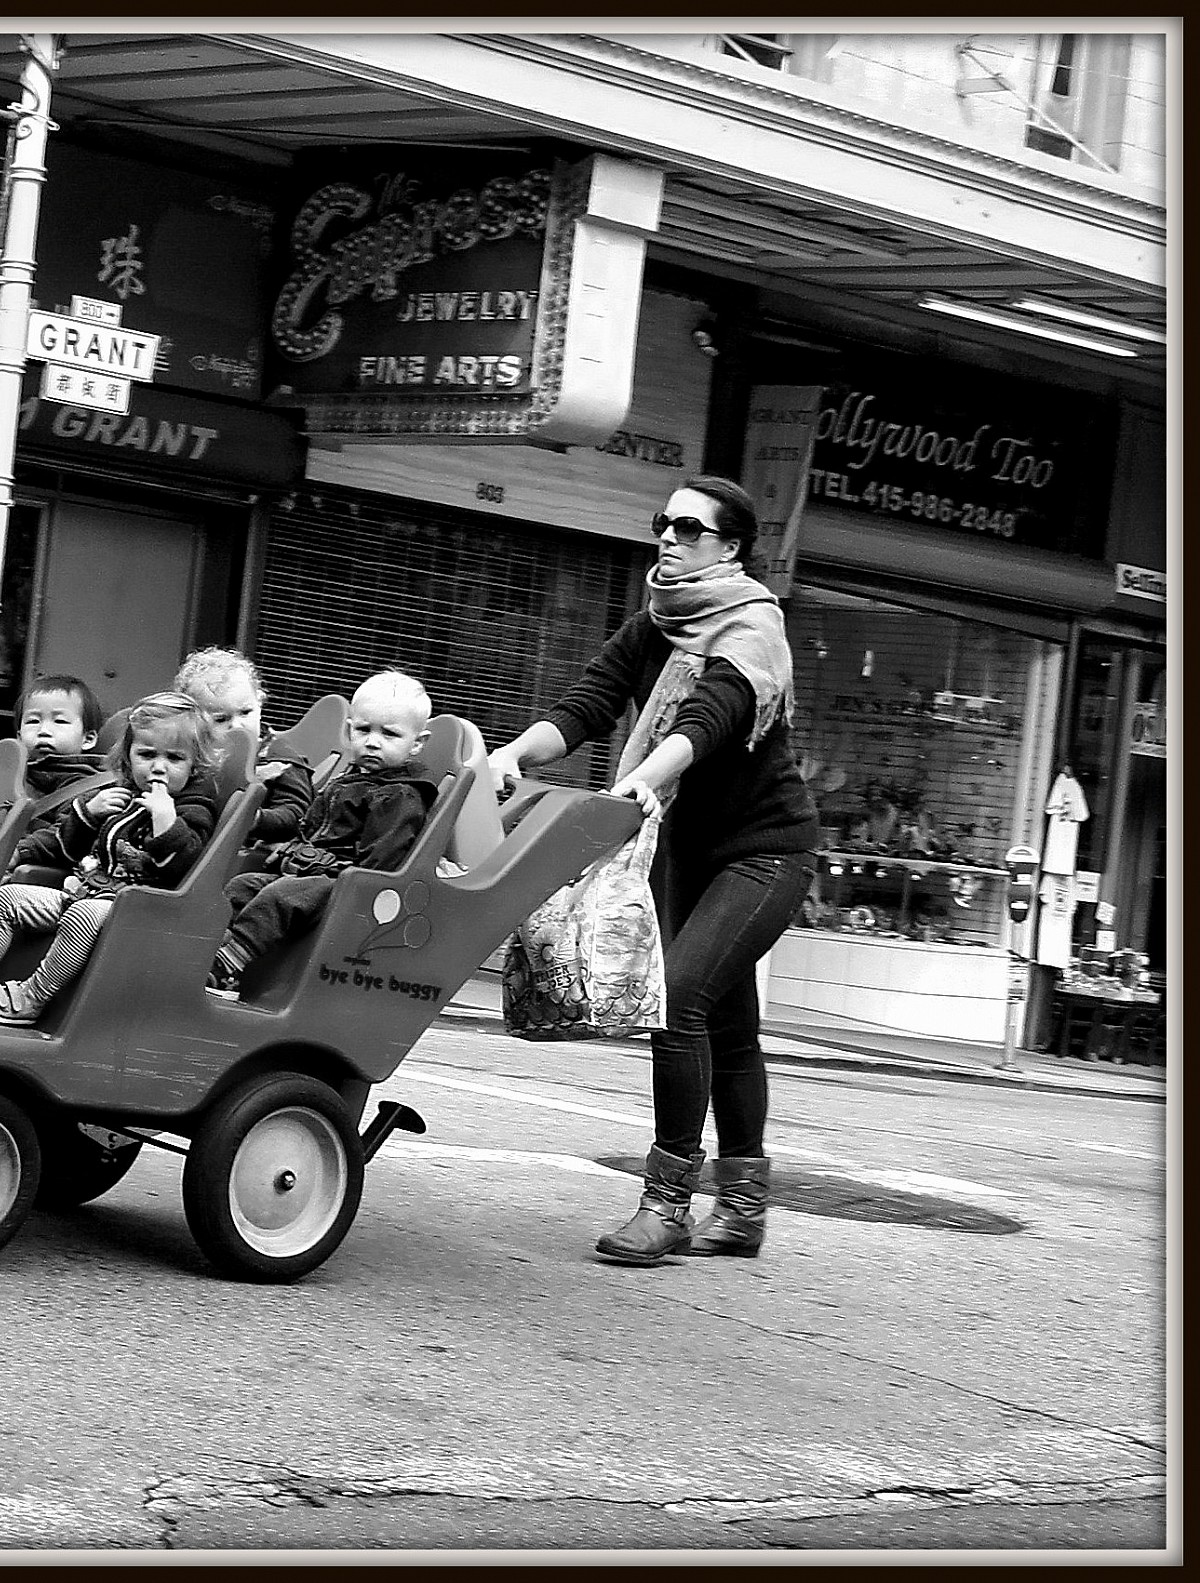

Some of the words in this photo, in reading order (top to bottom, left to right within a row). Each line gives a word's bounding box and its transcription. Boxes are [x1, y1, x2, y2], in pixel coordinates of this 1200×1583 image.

[98, 224, 147, 299] 珠
[396, 289, 538, 322] JEWELRY
[39, 323, 147, 369] GRANT
[359, 355, 426, 386] FINE
[433, 355, 524, 387] ARTS
[51, 404, 218, 460] GRANT
[814, 391, 992, 469] ollywood
[989, 436, 1054, 488] Too
[319, 963, 349, 985] bye
[353, 969, 384, 992] bye
[388, 974, 442, 1002] buggy
